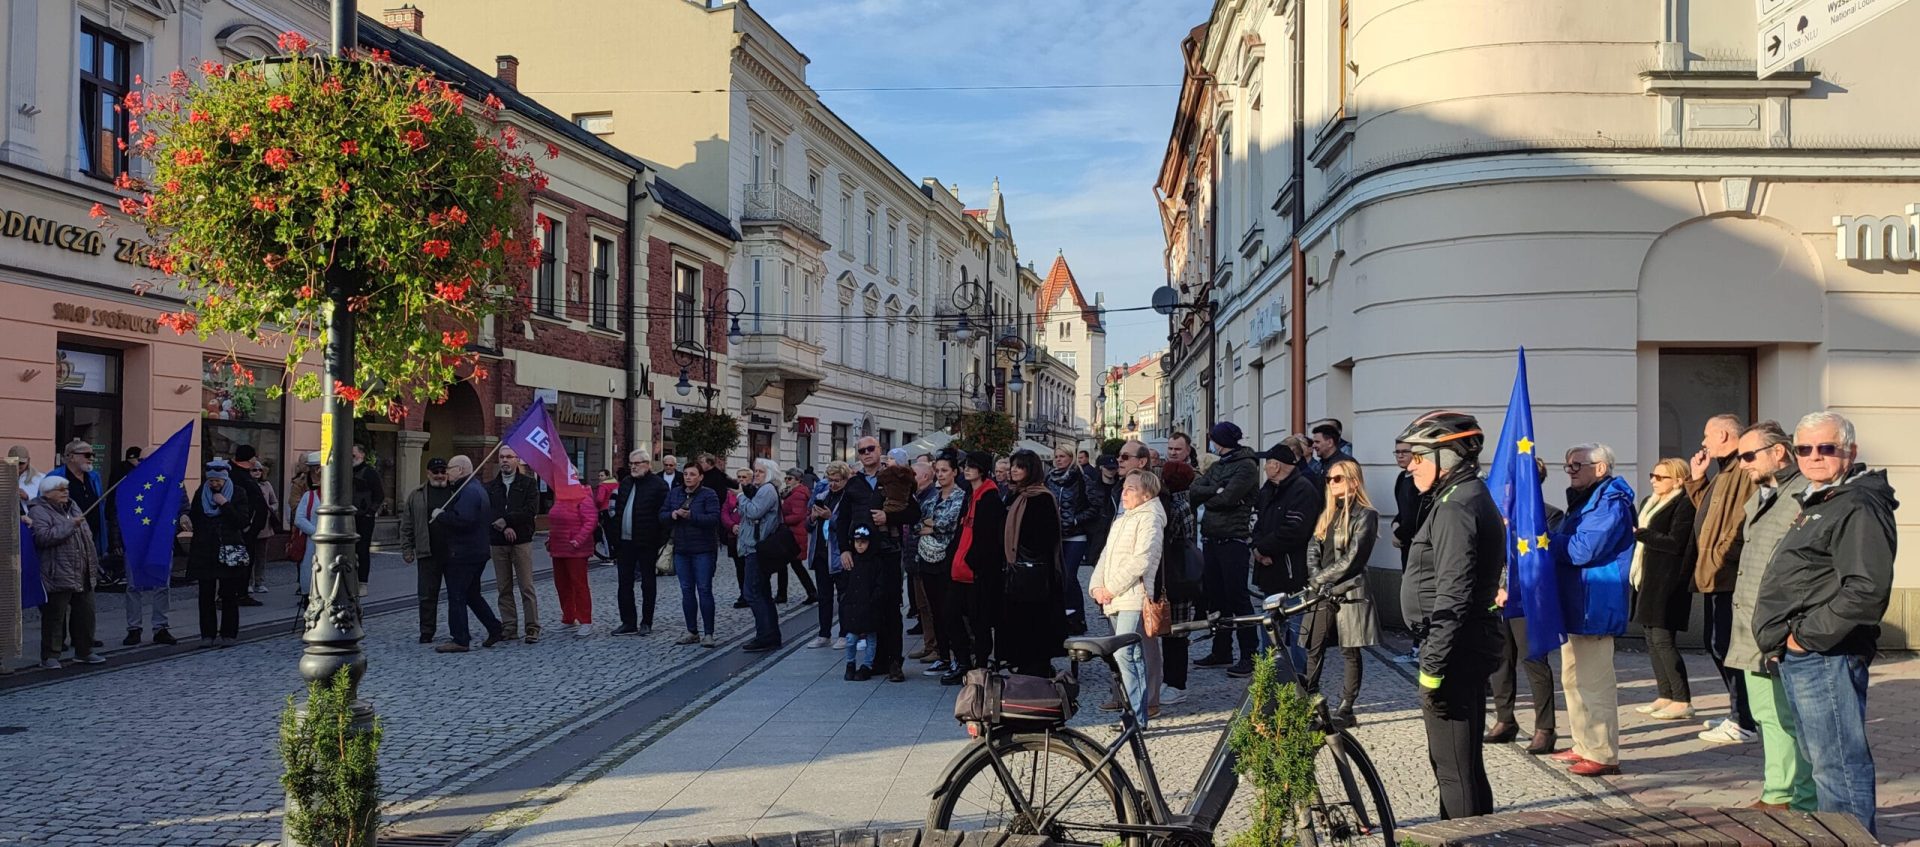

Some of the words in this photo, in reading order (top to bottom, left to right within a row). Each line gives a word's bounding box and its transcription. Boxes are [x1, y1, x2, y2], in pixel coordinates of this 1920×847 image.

[1830, 3, 1857, 25] National
[53, 302, 91, 323] SKLEP
[804, 423, 814, 433] M
[530, 430, 550, 449] LE
